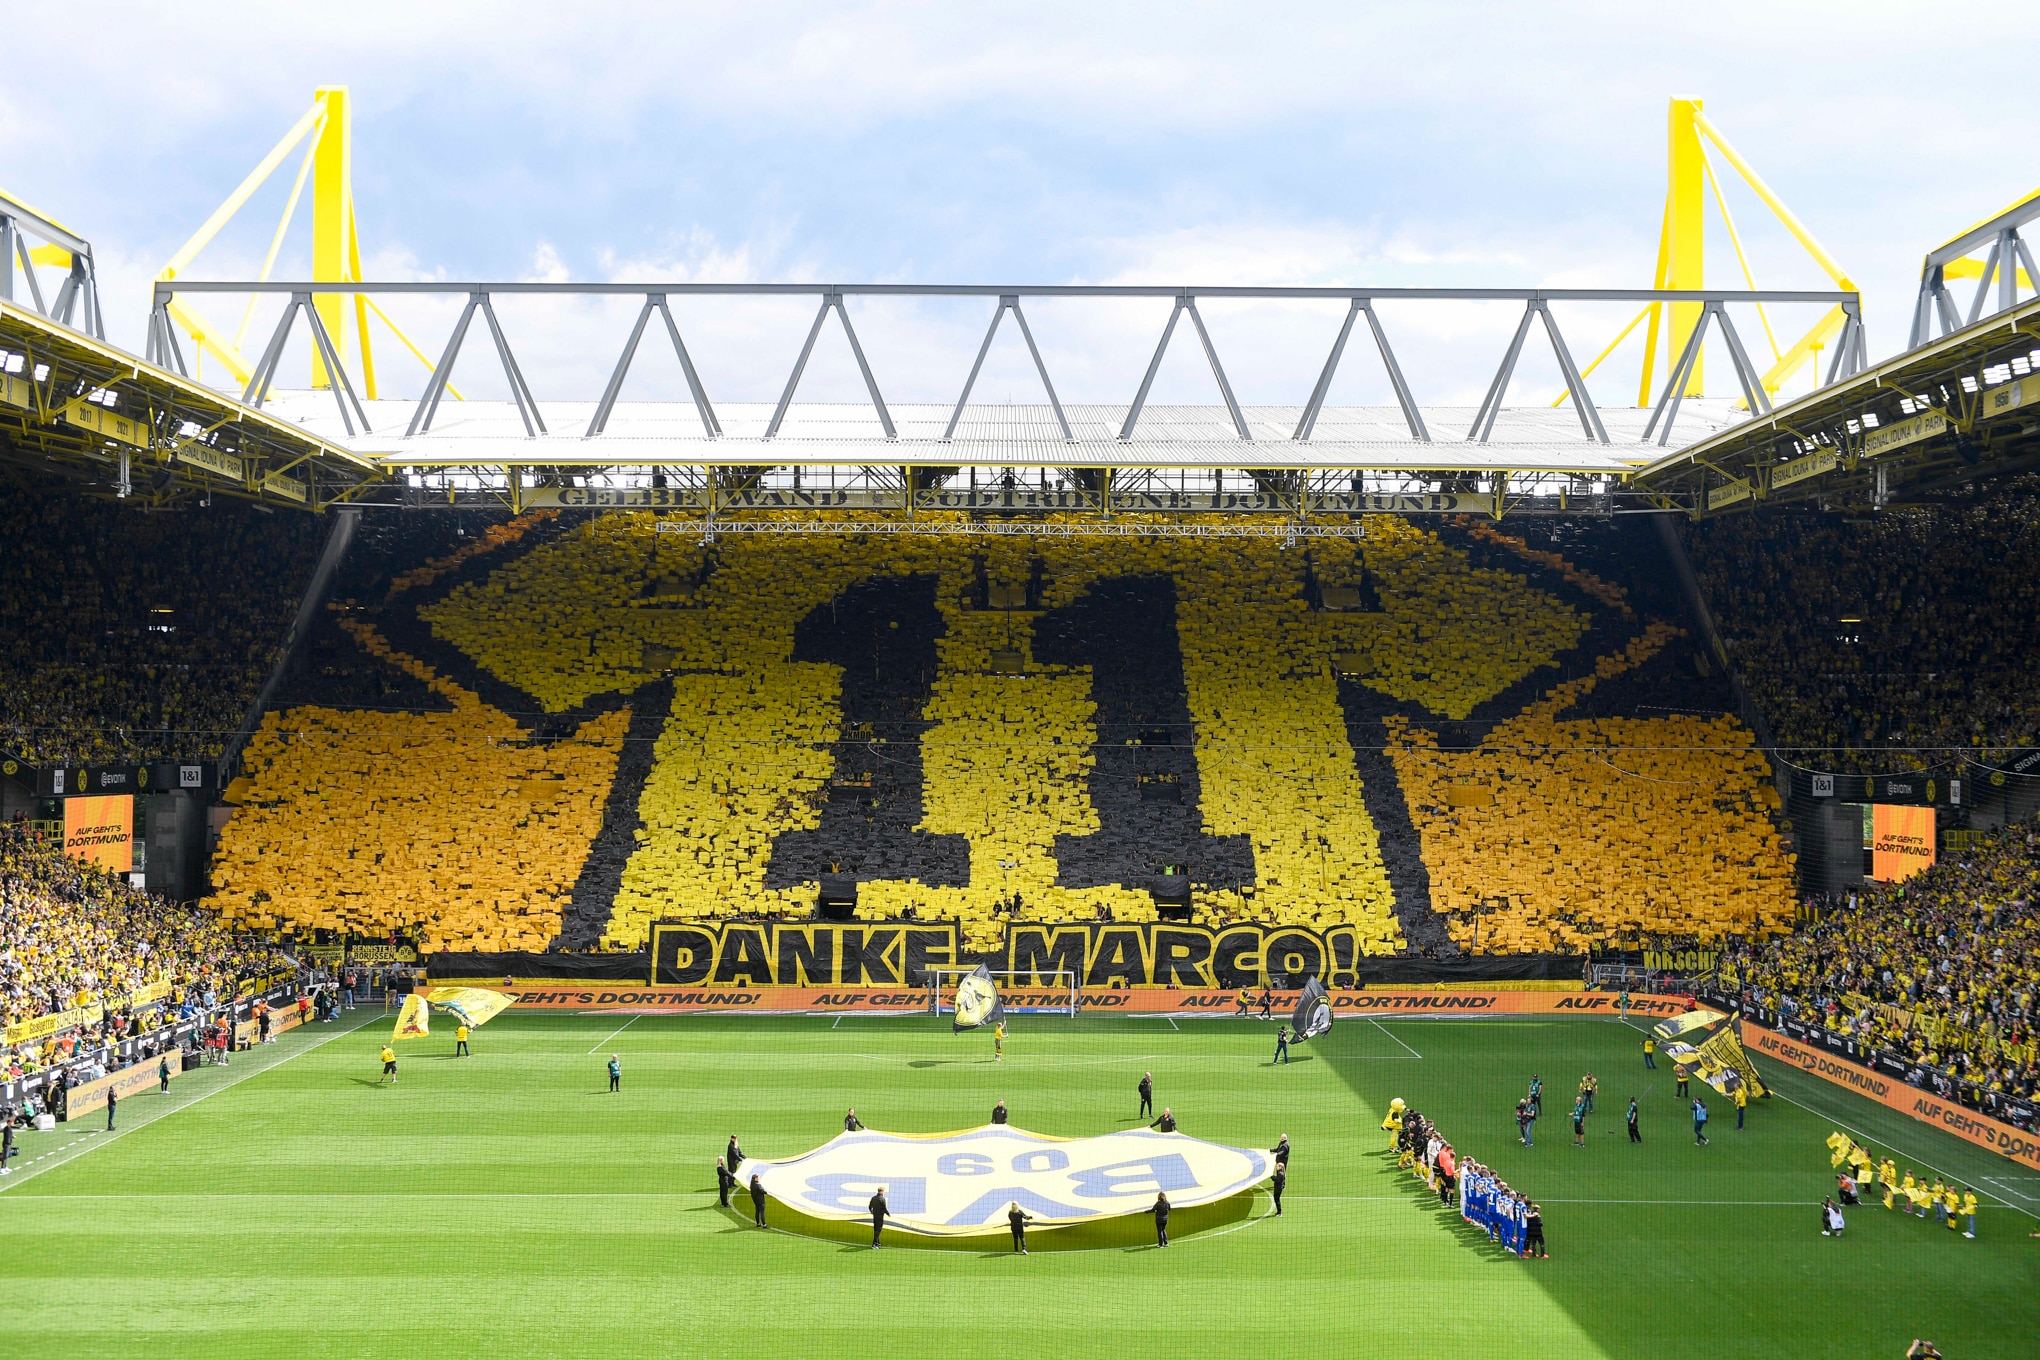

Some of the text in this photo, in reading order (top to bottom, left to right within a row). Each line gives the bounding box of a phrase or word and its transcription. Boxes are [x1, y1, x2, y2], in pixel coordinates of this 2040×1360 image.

[79, 406, 92, 424] 2017
[1866, 414, 1945, 452] SIGNAL IDUNA PARK
[179, 444, 241, 474] SIGNAL IDUNA PARK
[1773, 453, 1836, 484] SIGNAL IDUNA PARK
[557, 489, 698, 506] GELBE
[723, 489, 848, 506] WAND
[1211, 494, 1459, 511] DORTMUND
[182, 770, 199, 782] 1&1
[1814, 780, 1831, 791] 1&1
[75, 824, 122, 836] AUF GEHT'S
[67, 833, 131, 848] DORTMUND!
[1882, 834, 1924, 845] AUF GEHT'S
[1875, 843, 1933, 857] DORTMUND!
[352, 944, 397, 953] RENNSTEIG
[354, 952, 395, 961] BORUSSEN
[652, 922, 1360, 990] DANKE MARCO!
[597, 992, 762, 1005] DORTMUND!
[812, 993, 867, 1006] AUF
[1179, 995, 1234, 1007] AUF
[1332, 996, 1498, 1008] DORTMUND!
[1553, 997, 1610, 1009] AUF
[1758, 1035, 1779, 1052] AUF
[1780, 1042, 1817, 1067] GEHT'S
[1818, 1058, 1890, 1099] DORTMUND!
[69, 1091, 91, 1111] AUF
[1913, 1098, 1943, 1119] AUF
[1943, 1109, 1997, 1143] GEHT'S
